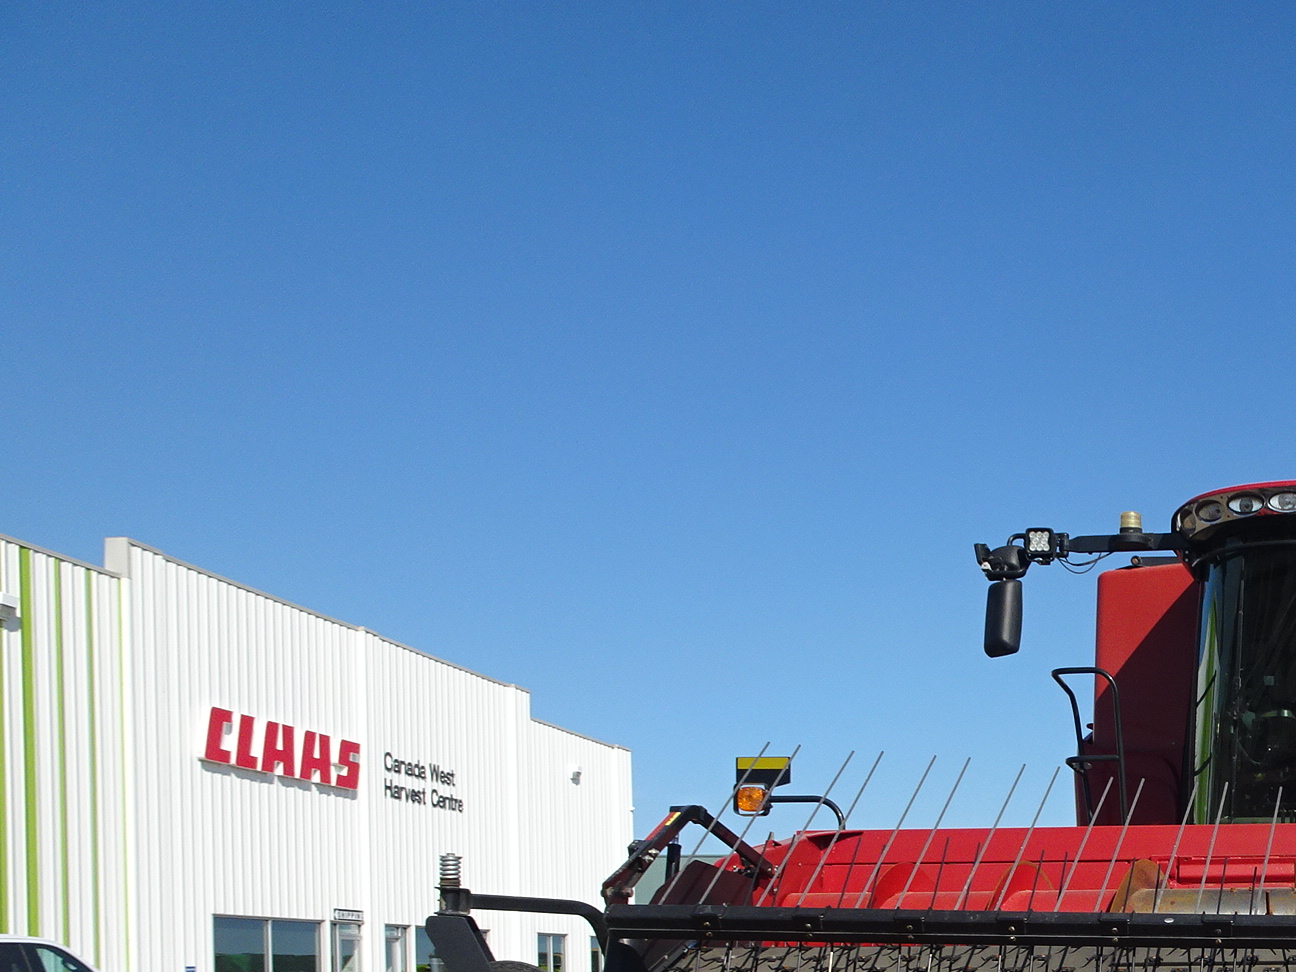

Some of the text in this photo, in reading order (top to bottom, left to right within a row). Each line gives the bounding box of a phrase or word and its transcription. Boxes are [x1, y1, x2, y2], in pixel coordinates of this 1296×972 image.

[205, 706, 361, 790] CLAAS
[384, 752, 456, 787] Canada West
[384, 778, 464, 814] Harvest Centre
